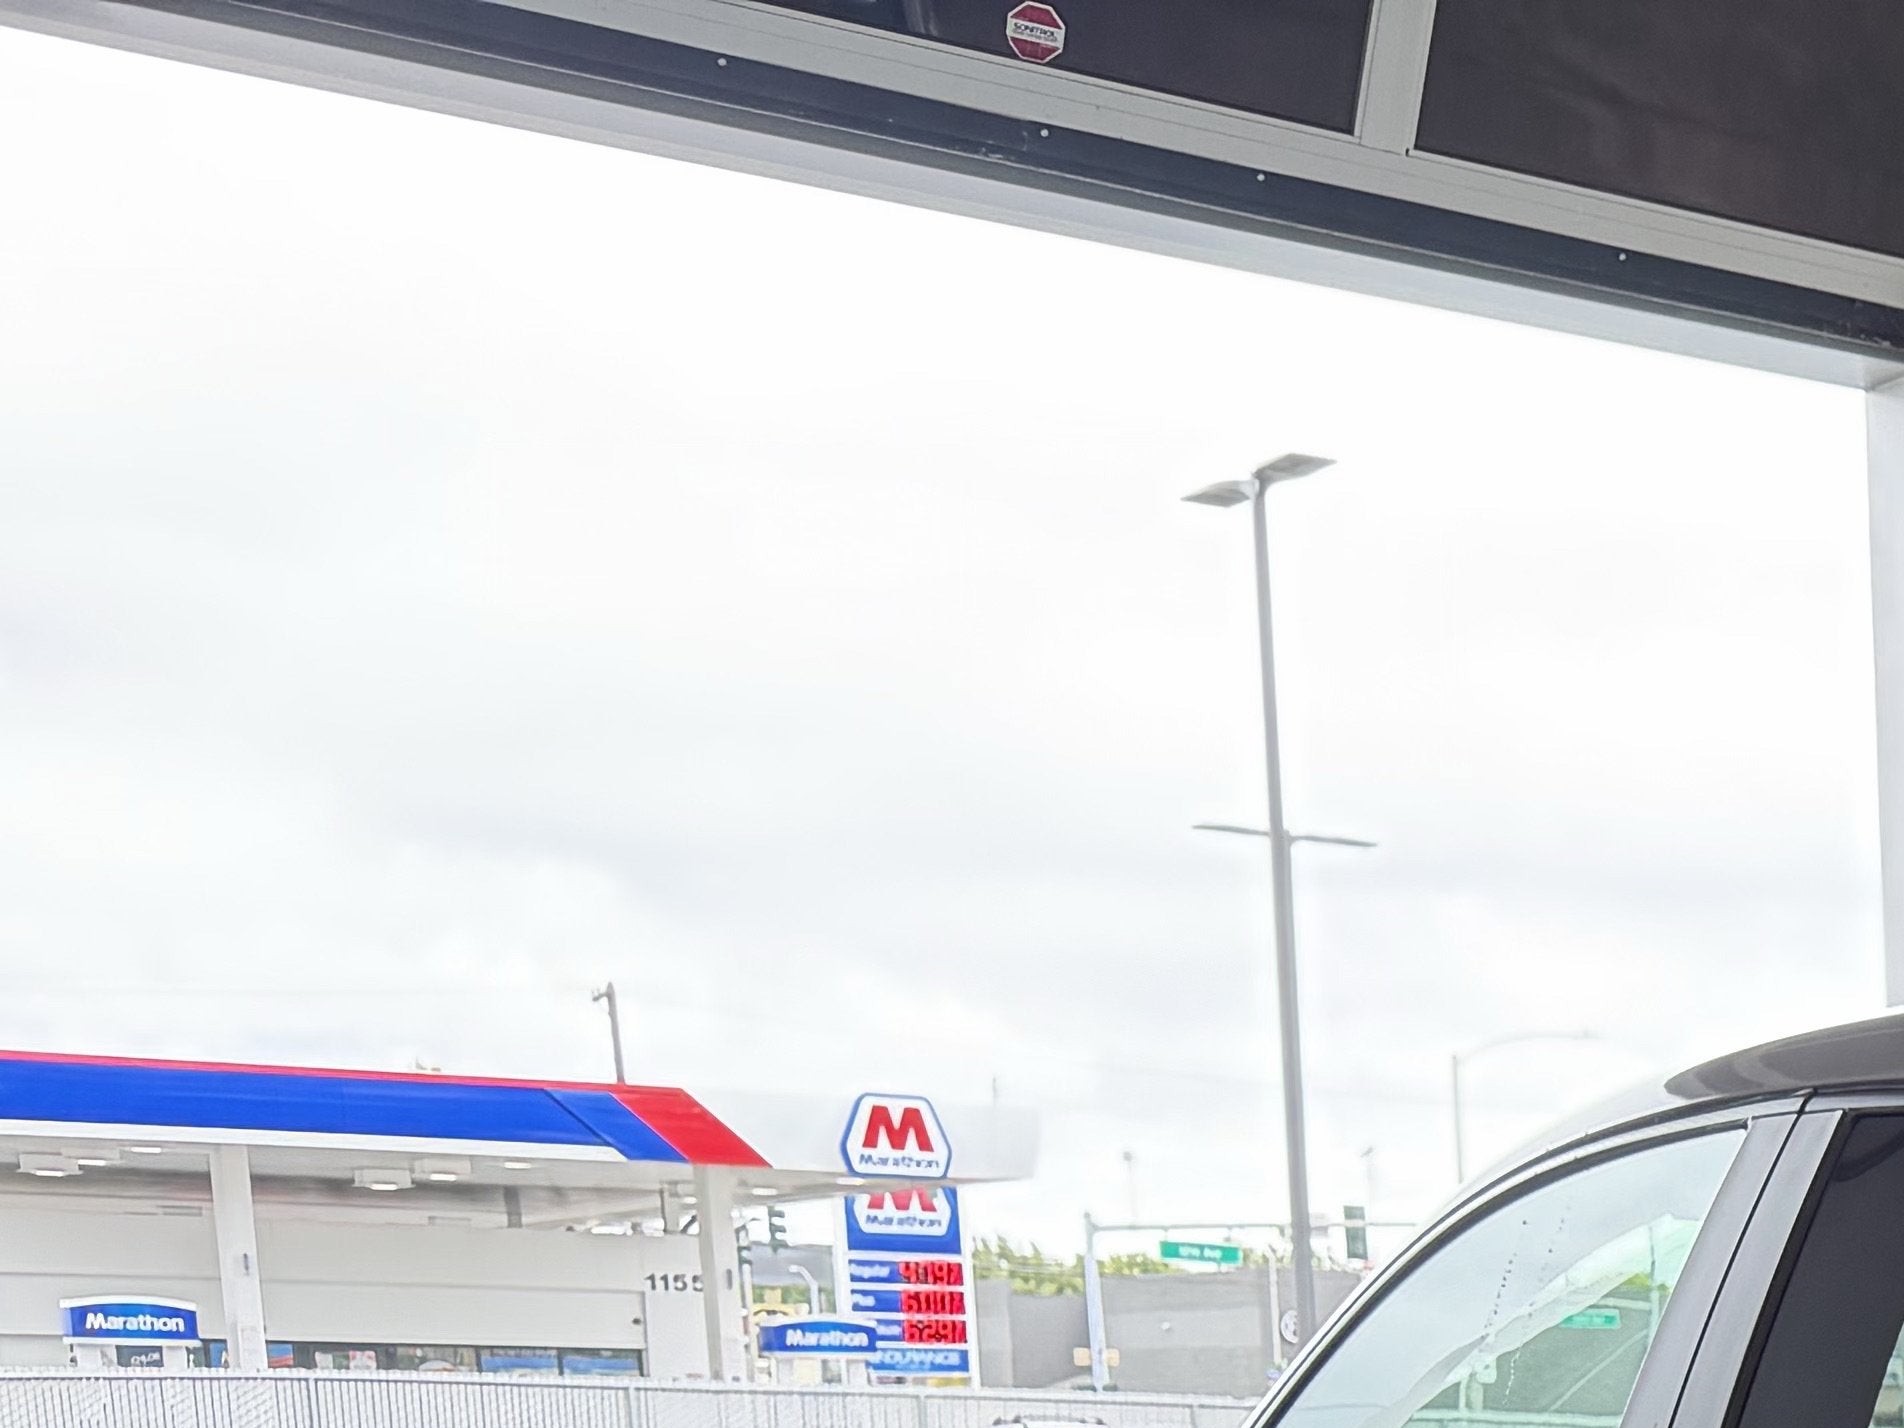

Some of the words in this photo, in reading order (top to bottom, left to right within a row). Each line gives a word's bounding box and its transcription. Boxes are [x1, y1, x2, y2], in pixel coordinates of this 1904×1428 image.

[862, 1104, 934, 1153] M
[85, 1312, 185, 1333] Marathon
[786, 1329, 869, 1347] Marathon
